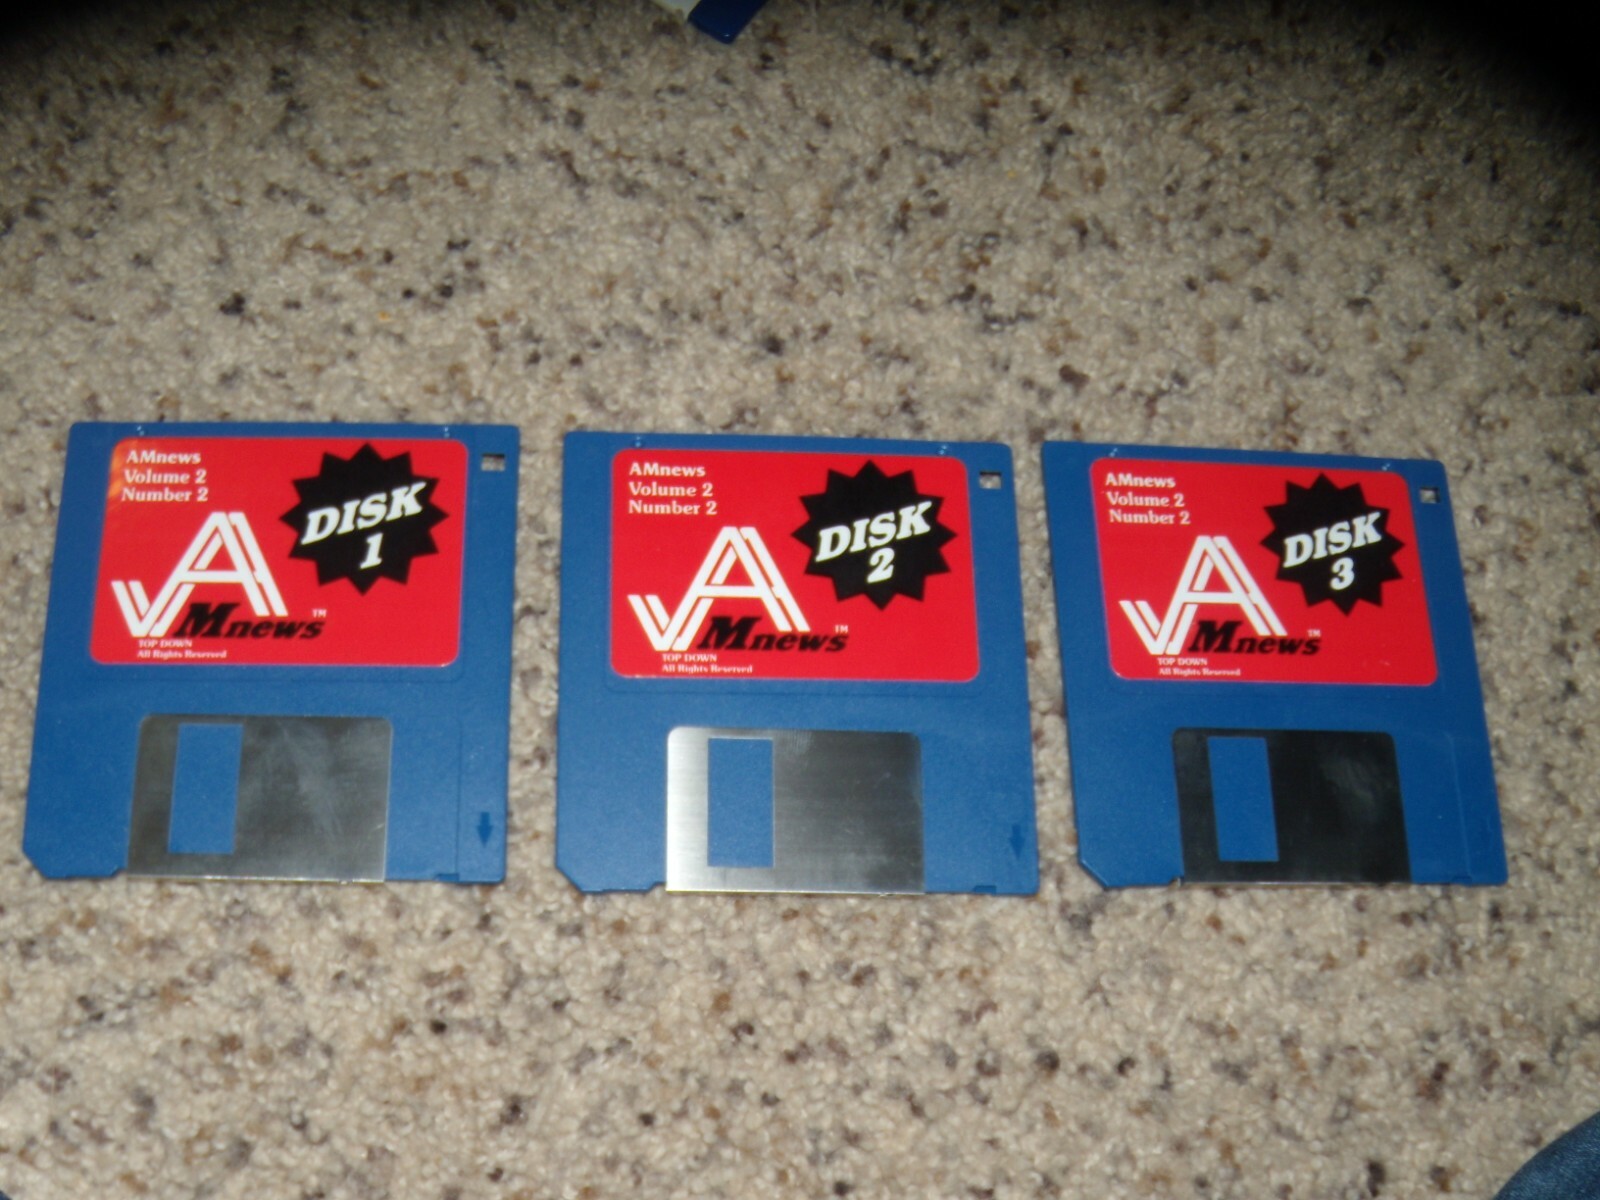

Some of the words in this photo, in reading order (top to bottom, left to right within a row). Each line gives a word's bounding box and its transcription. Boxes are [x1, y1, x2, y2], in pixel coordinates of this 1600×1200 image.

[126, 451, 201, 464] AMnews
[124, 469, 189, 484] Volume
[195, 470, 206, 483] 2
[629, 463, 705, 477] AMnews
[1105, 474, 1175, 488] AMnews
[122, 488, 192, 502] Number
[197, 488, 208, 502] 2
[629, 482, 696, 497] Volume
[702, 483, 713, 497] 2
[1107, 492, 1169, 506] Volume
[1174, 494, 1184, 507] 2
[300, 482, 426, 545] DISK
[628, 501, 700, 514] Number
[706, 501, 717, 515] 2
[1109, 510, 1175, 524] Number
[1180, 512, 1190, 525] 2
[815, 501, 932, 562] DISK
[1283, 512, 1382, 568] DISK
[360, 533, 383, 570] 1
[867, 548, 895, 583] 2
[1330, 558, 1354, 590] 3
[138, 640, 158, 648] TOP
[160, 640, 192, 648] DOWN
[137, 650, 152, 658] All
[153, 650, 183, 660] Rights
[185, 650, 227, 659] Reserved
[662, 654, 682, 662] TOP
[684, 654, 717, 662] DOWN
[1178, 658, 1207, 666] DOWN
[662, 664, 676, 672] All
[678, 664, 708, 674] Rights
[711, 665, 752, 673] Reserved
[1173, 668, 1201, 677] Rights
